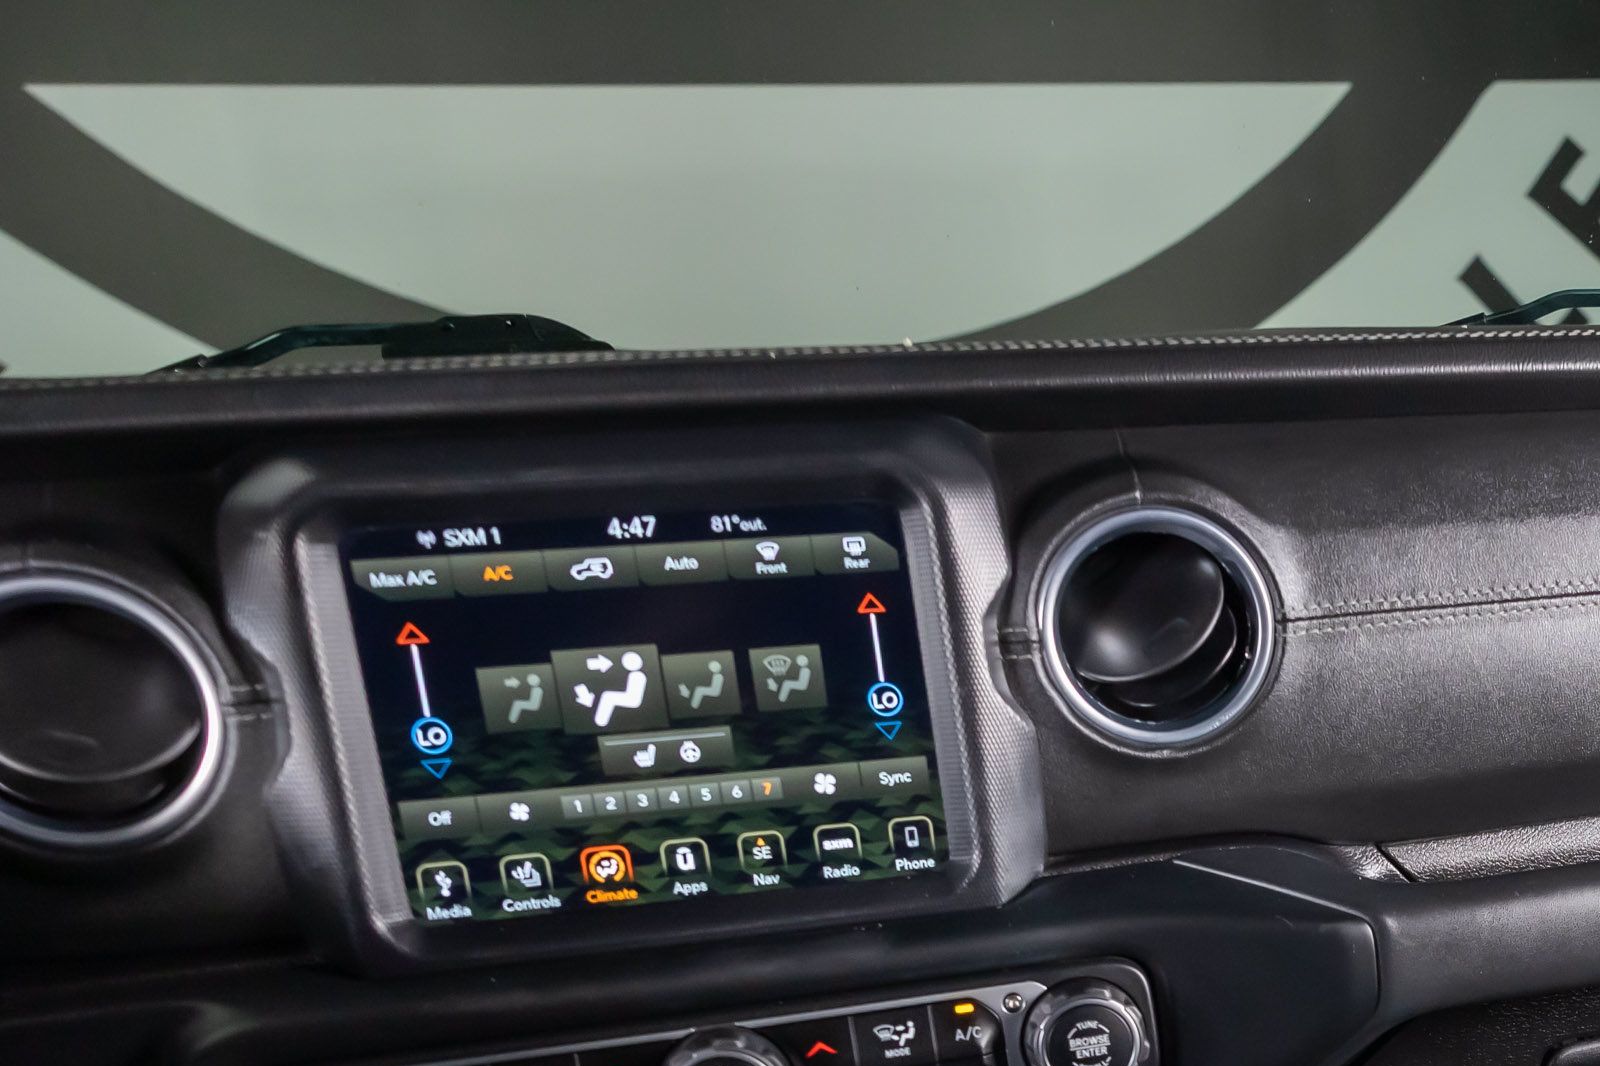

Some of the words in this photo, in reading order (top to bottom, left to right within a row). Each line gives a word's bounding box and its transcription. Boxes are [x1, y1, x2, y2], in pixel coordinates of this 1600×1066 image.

[607, 515, 656, 539] 4:47
[443, 527, 487, 547] SXM
[490, 526, 501, 544] 1
[664, 556, 699, 571] Auto
[755, 561, 788, 575] Front
[843, 556, 871, 569] Rear
[369, 572, 406, 588] Max
[406, 569, 437, 586] A/C
[482, 564, 514, 582] A/C
[872, 690, 899, 710] LO
[416, 726, 447, 747] LO
[878, 770, 912, 787] Sync
[701, 787, 712, 802] 5
[731, 785, 742, 798] 6
[762, 781, 772, 796] 7
[605, 796, 617, 810] 2
[637, 794, 648, 807] 3
[669, 791, 680, 804] 4
[573, 799, 582, 813] 1
[428, 810, 452, 826] Off
[753, 846, 773, 860] SE
[895, 856, 936, 871] Phone
[753, 873, 780, 887] Nav
[823, 866, 861, 880] Radio
[586, 887, 639, 904] Climate
[673, 881, 708, 896] Apps
[502, 895, 562, 913] Controls
[426, 903, 472, 921] Media
[954, 1025, 984, 1042] A/C
[1069, 1034, 1110, 1048] BROWSE
[884, 1047, 912, 1059] MODE
[1075, 1046, 1108, 1059] ENTER
